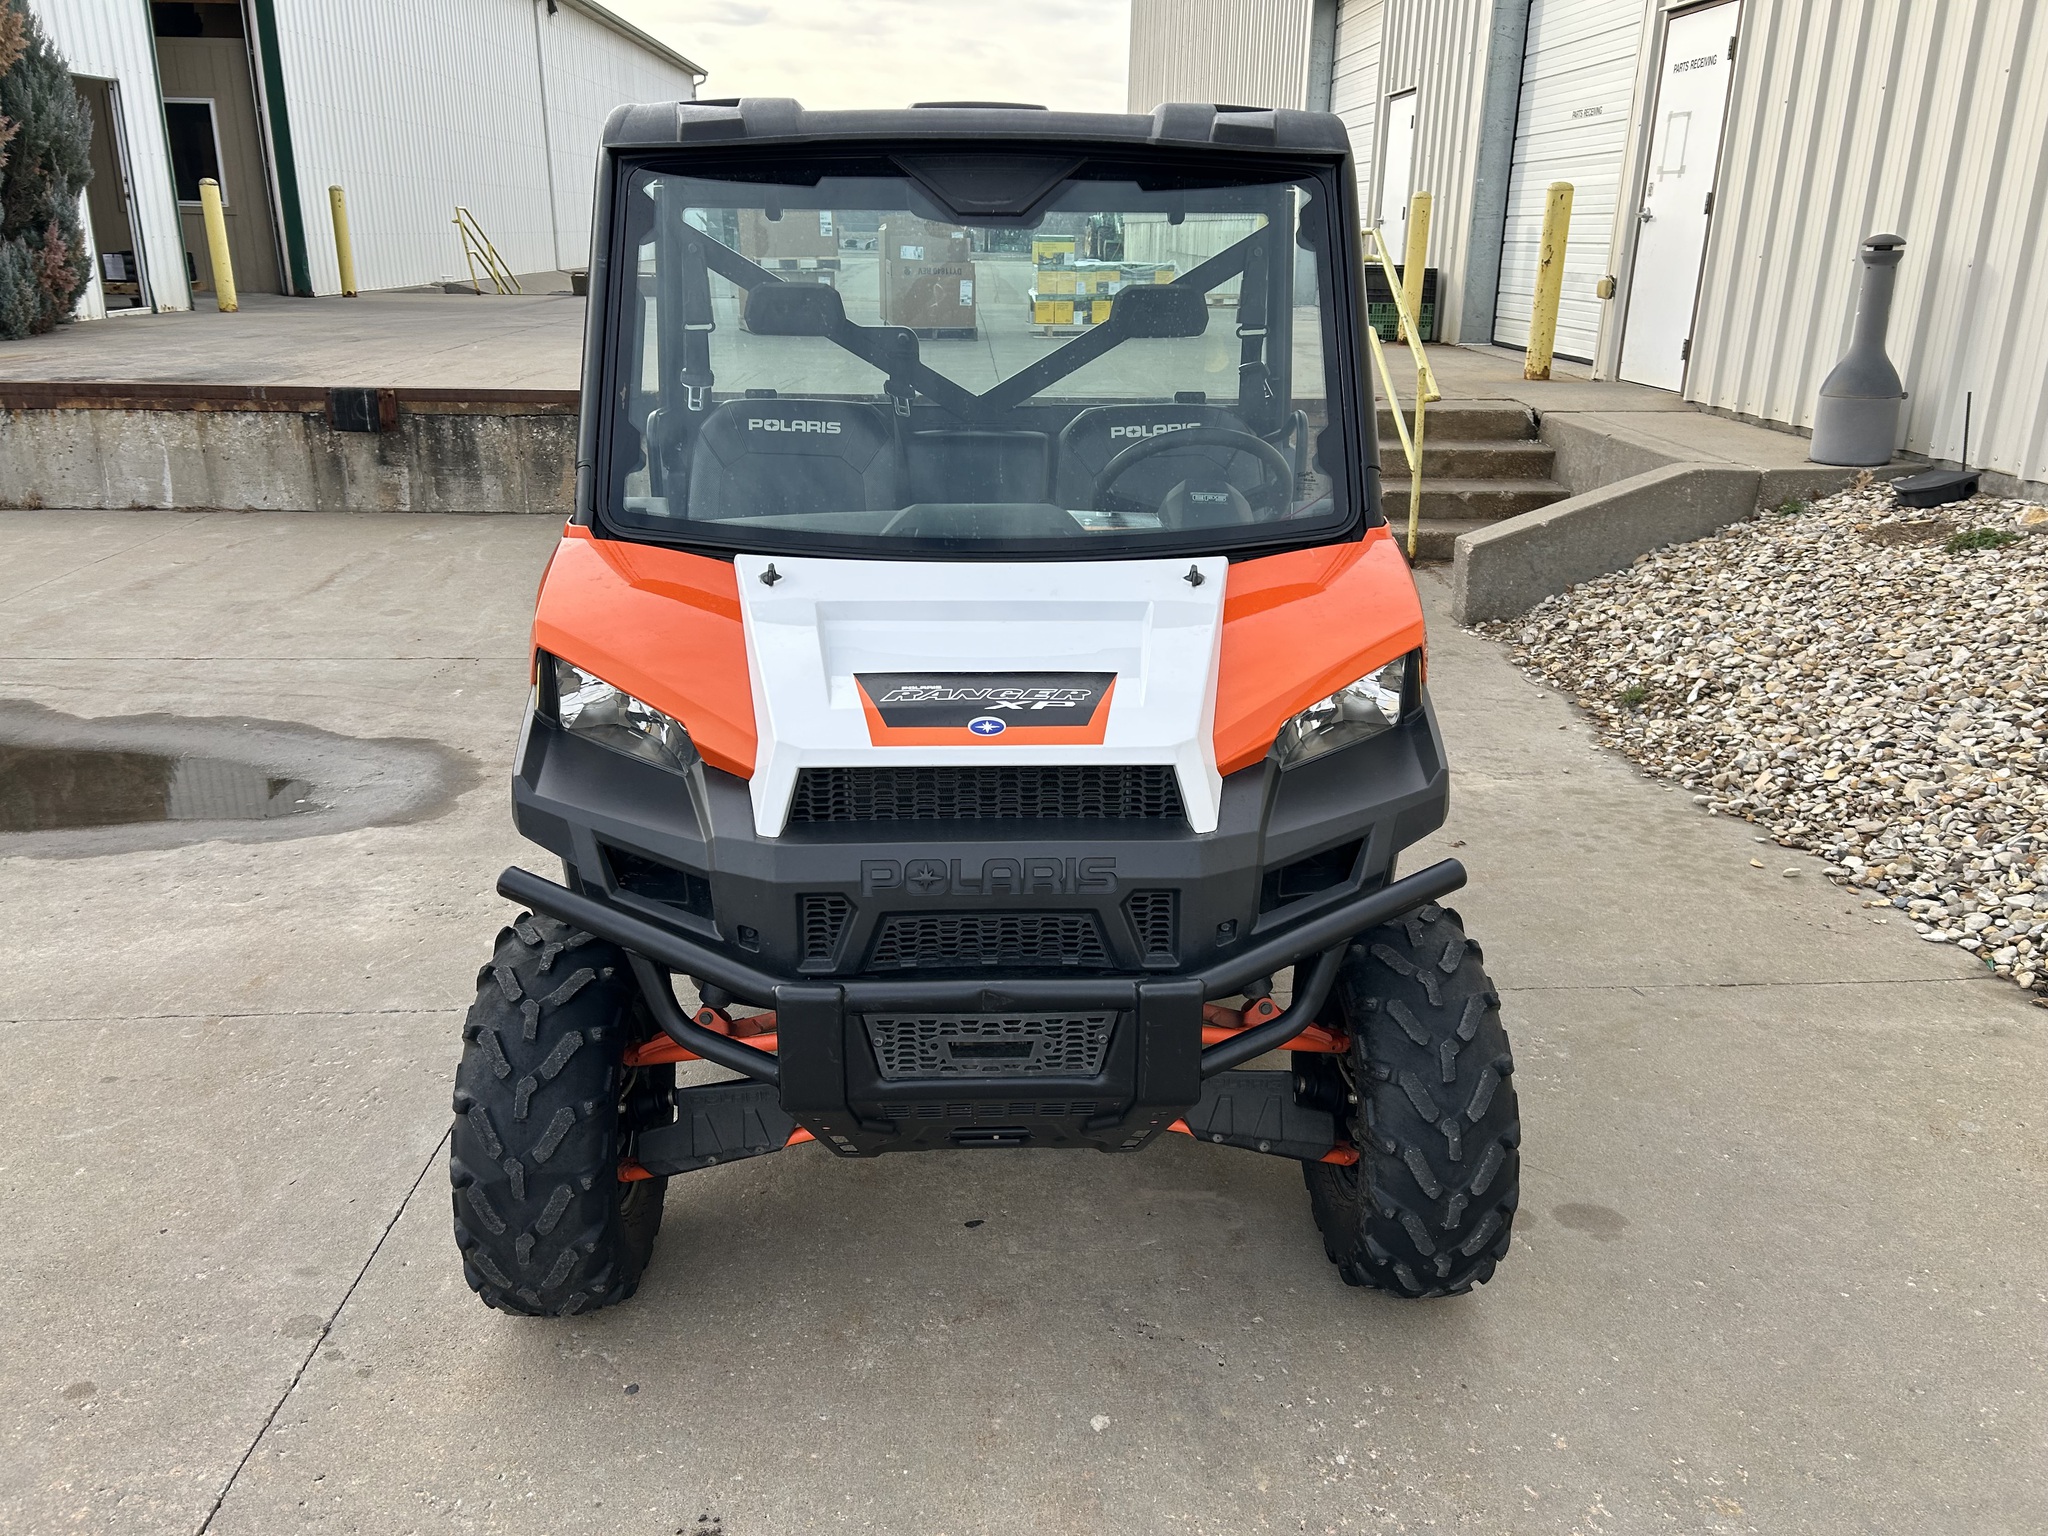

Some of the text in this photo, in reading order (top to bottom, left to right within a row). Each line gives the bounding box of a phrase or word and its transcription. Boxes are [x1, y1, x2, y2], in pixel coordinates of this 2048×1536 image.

[1673, 54, 1717, 74] PARTS RECEIVING
[1572, 109, 1584, 120] PARTS
[748, 418, 842, 434] POLARIS
[880, 688, 1092, 703] RANGER
[984, 700, 1076, 710] XP
[860, 857, 1119, 897] POLARIS
